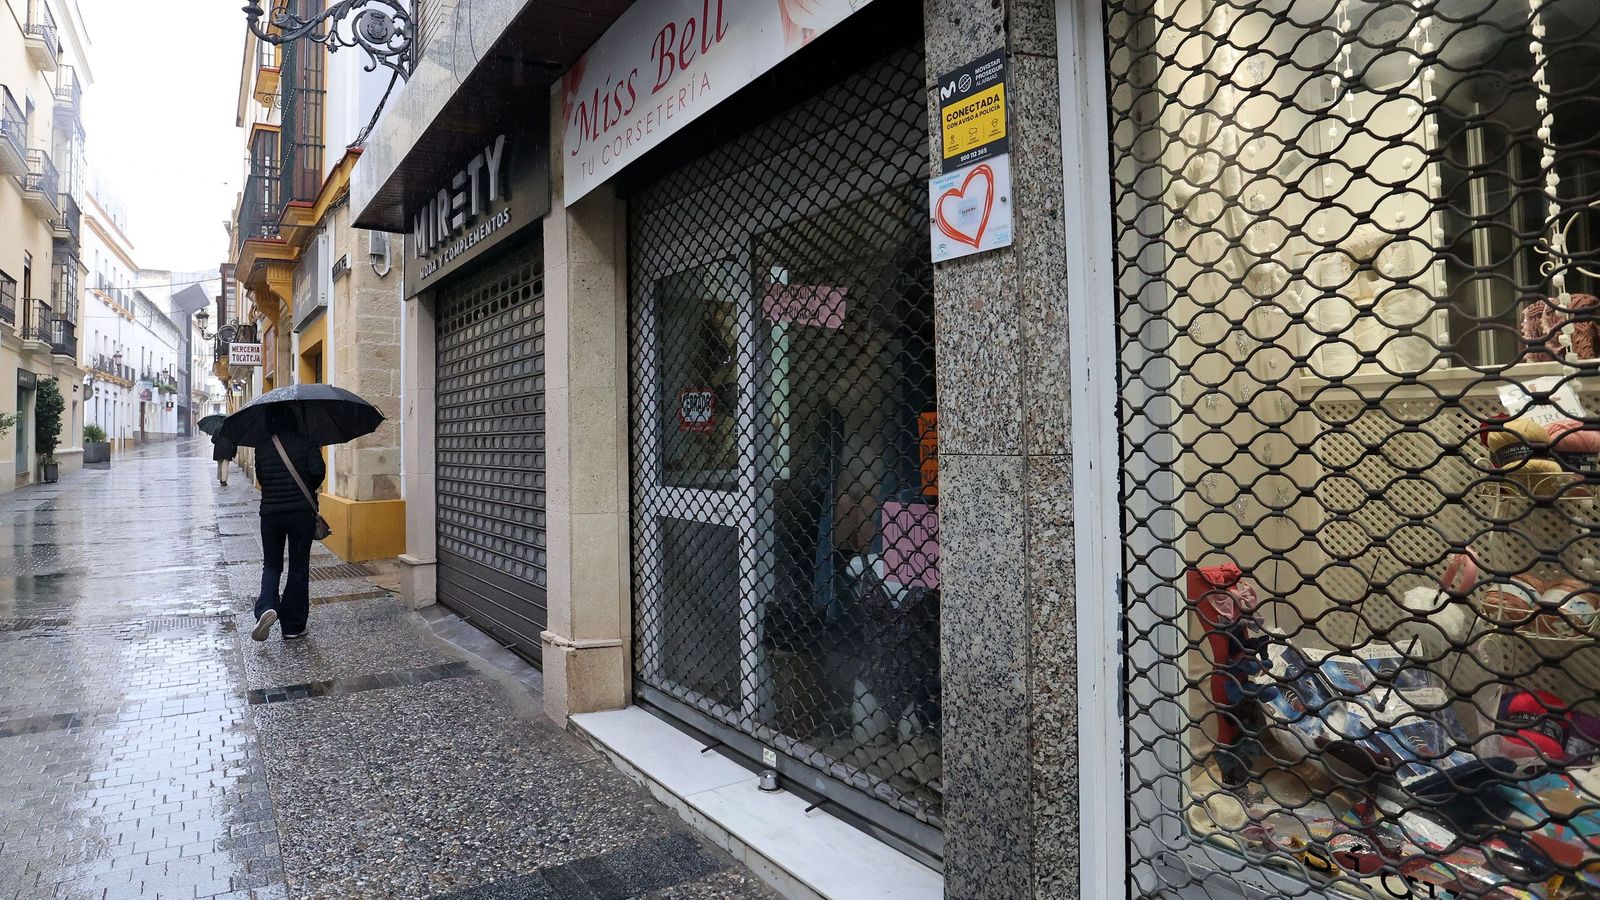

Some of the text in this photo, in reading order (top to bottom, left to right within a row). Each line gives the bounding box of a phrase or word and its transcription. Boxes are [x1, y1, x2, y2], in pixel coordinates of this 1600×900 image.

[975, 58, 1001, 74] MOVISTAR
[976, 63, 1003, 80] PROSEGUR
[572, 0, 729, 156] Miss Bell
[976, 73, 998, 86] ALARMAS
[946, 94, 1000, 122] CONECTADA
[581, 71, 711, 181] TU CORSETERÍA
[947, 121, 958, 130] CON
[959, 115, 974, 125] AVISO
[960, 154, 970, 162] 900
[419, 258, 437, 280] MODA
[444, 207, 511, 262] COMPLEMENTOS
